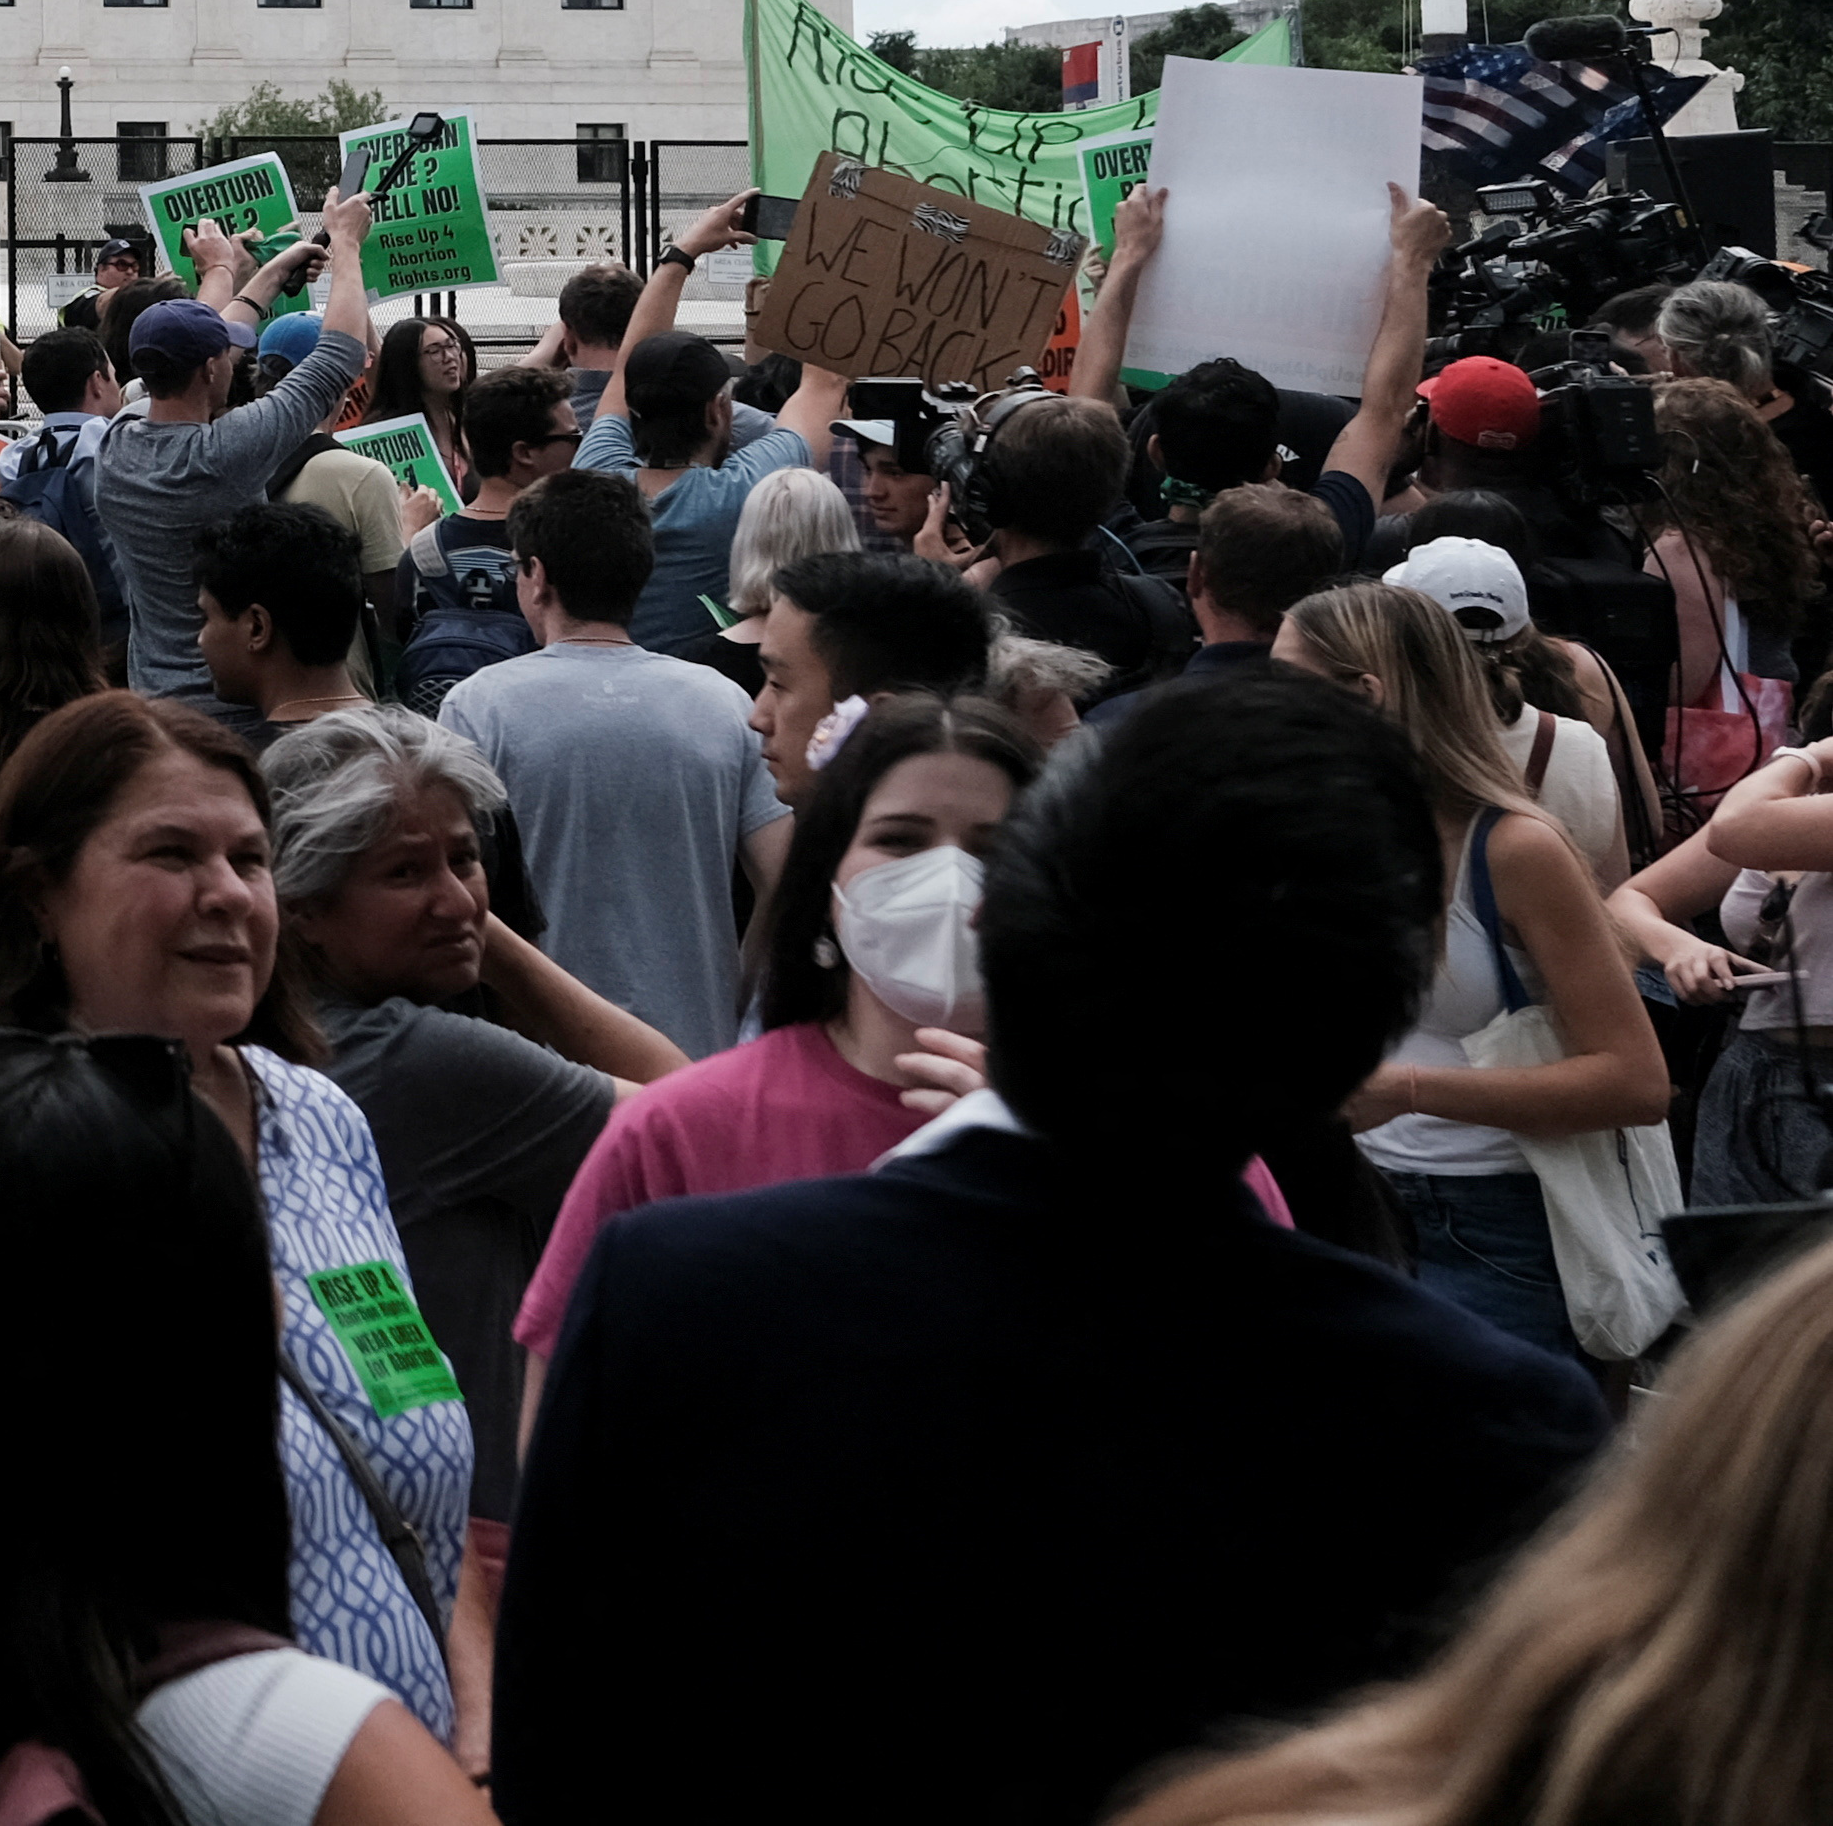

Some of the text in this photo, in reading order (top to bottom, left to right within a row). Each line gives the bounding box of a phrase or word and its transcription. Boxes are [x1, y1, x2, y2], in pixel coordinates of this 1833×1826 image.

[965, 107, 1084, 164] Up
[424, 157, 438, 183] ?
[163, 169, 274, 222] OVERTURN
[421, 185, 461, 216] NO!
[379, 225, 454, 249] Rise Up 4
[389, 247, 457, 268] Abortion
[805, 202, 1060, 340] WE WON'T
[388, 265, 471, 289] Rights.org
[785, 281, 1020, 392] GO BACK
[316, 1274, 364, 1308] RISE
[354, 1269, 383, 1298] UP
[351, 1329, 393, 1355] WEAR
